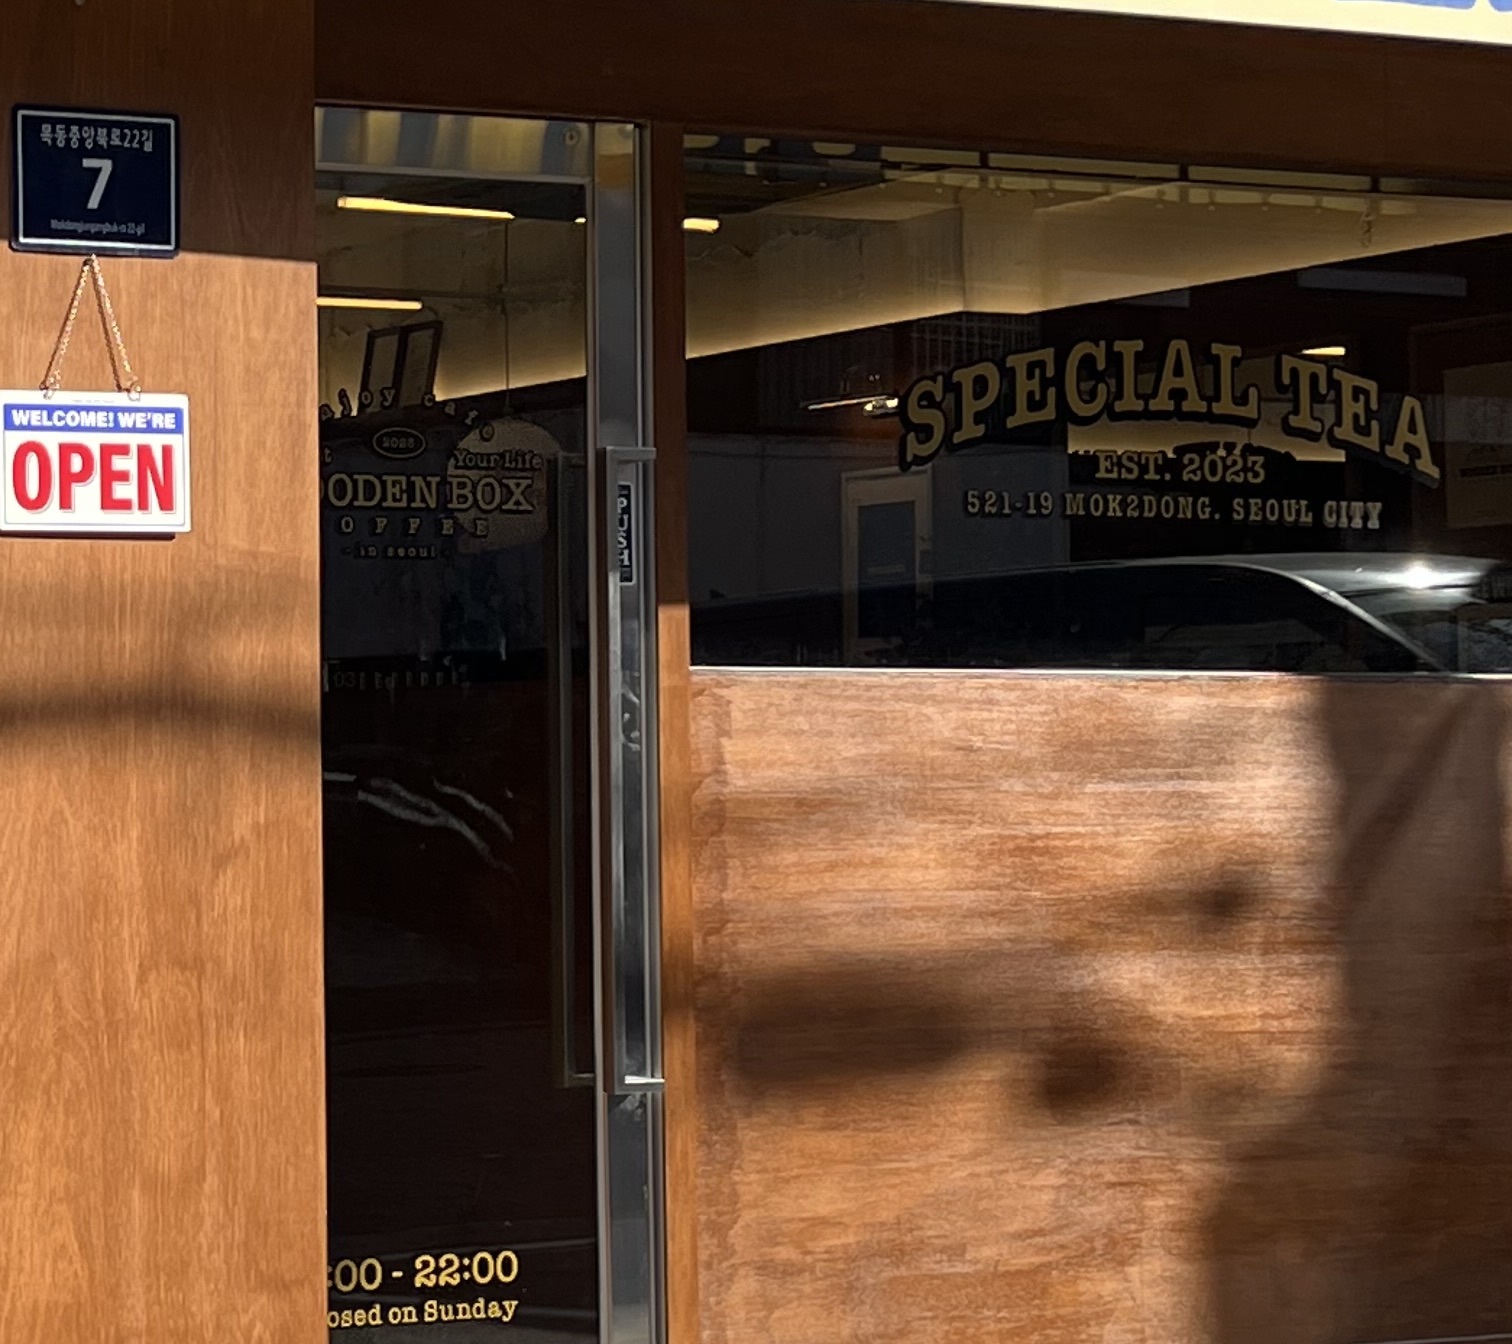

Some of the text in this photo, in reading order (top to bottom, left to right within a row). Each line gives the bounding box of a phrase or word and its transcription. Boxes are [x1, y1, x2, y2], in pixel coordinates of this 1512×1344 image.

[81, 157, 114, 210] 7
[11, 408, 176, 430] WELCOME! WE'RE
[320, 386, 398, 423] njoy
[902, 338, 1441, 481] SPECIAL TEA
[11, 439, 176, 513] OPEN
[453, 449, 544, 470] Your Life
[1094, 452, 1266, 485] EST. 2023
[320, 471, 535, 514] ODEN BOX
[965, 489, 1055, 516] 521-19
[1231, 497, 1314, 524] SEOUL
[1323, 500, 1384, 530] CITY
[339, 515, 489, 538] OFFEE
[328, 1258, 383, 1292] :00
[414, 1250, 519, 1288] 22:00
[328, 1297, 519, 1328] osed on Sunday
